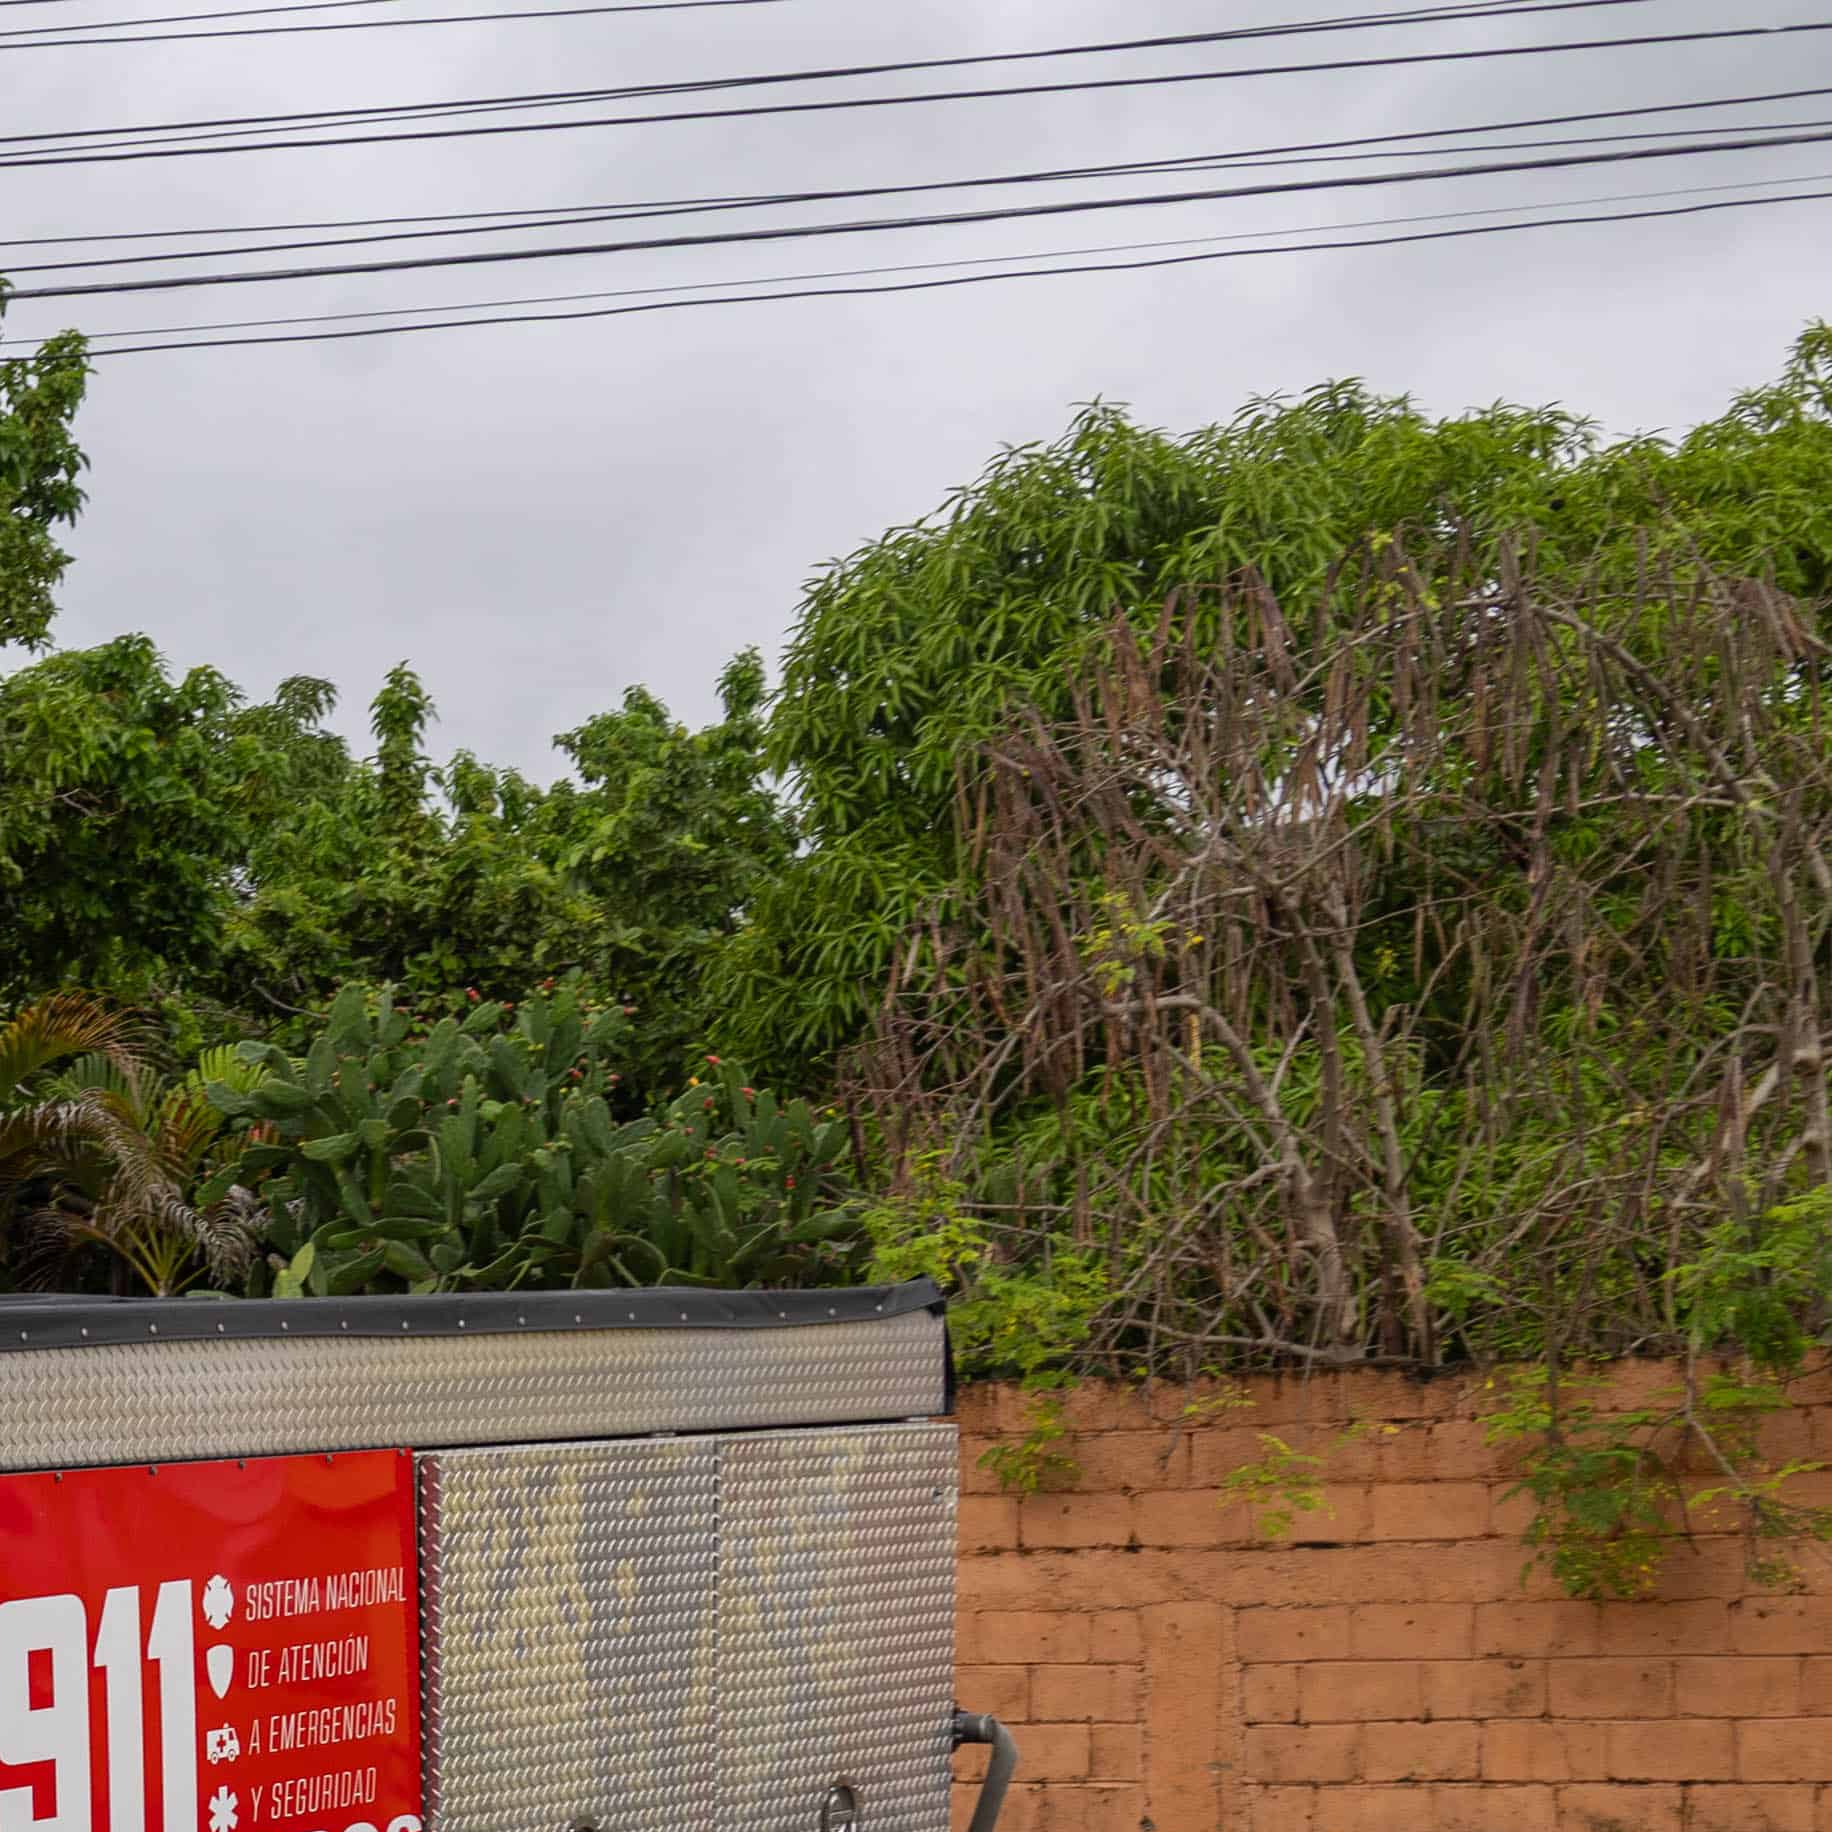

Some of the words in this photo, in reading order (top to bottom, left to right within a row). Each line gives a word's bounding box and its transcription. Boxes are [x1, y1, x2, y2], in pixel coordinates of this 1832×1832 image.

[246, 1581, 320, 1621] SISTEMA
[325, 1566, 406, 1611] NACIONAL
[248, 1650, 272, 1689] DE
[278, 1632, 368, 1684] ATENCIÓN
[248, 1719, 261, 1755] A
[269, 1699, 396, 1752] EMERGENCIAS
[250, 1785, 263, 1823] Y
[270, 1767, 377, 1820] SEGURIDAD
